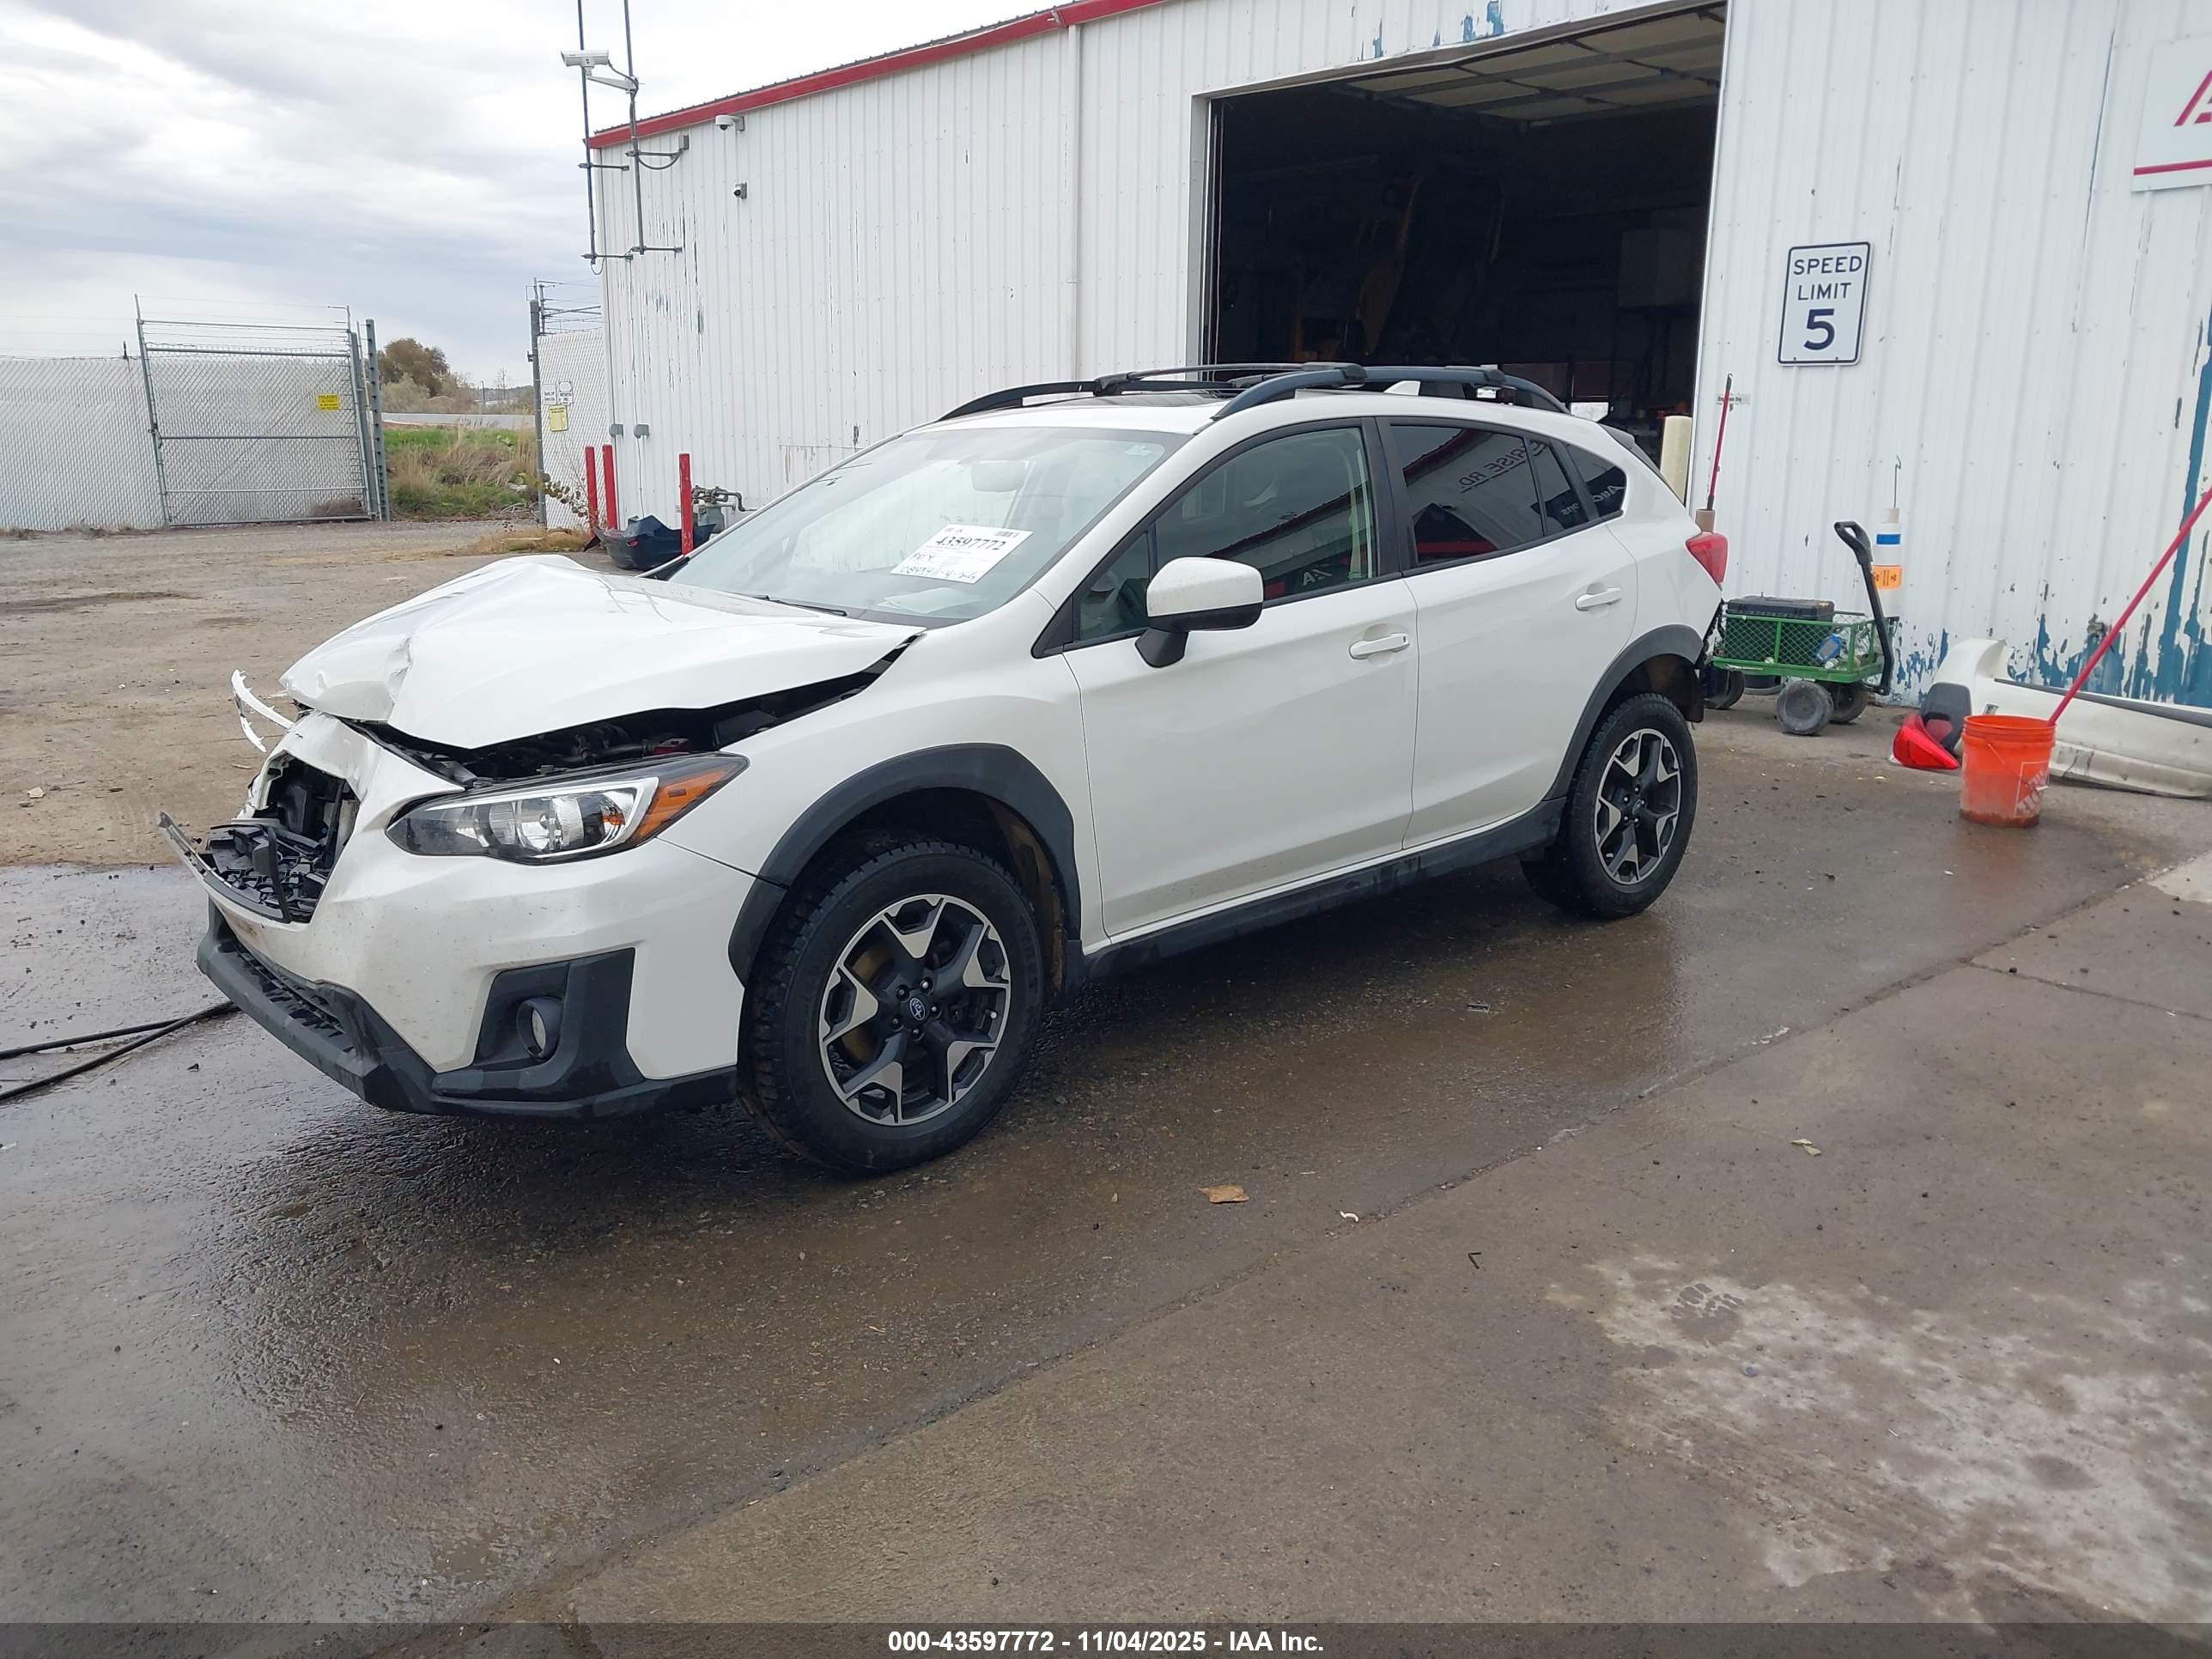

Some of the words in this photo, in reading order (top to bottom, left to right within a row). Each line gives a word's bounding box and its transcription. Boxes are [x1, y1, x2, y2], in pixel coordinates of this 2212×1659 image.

[1793, 255, 1863, 276] SPEED
[1797, 282, 1852, 301] LIMIT
[1803, 307, 1835, 351] 5
[936, 536, 1007, 550] 43597772
